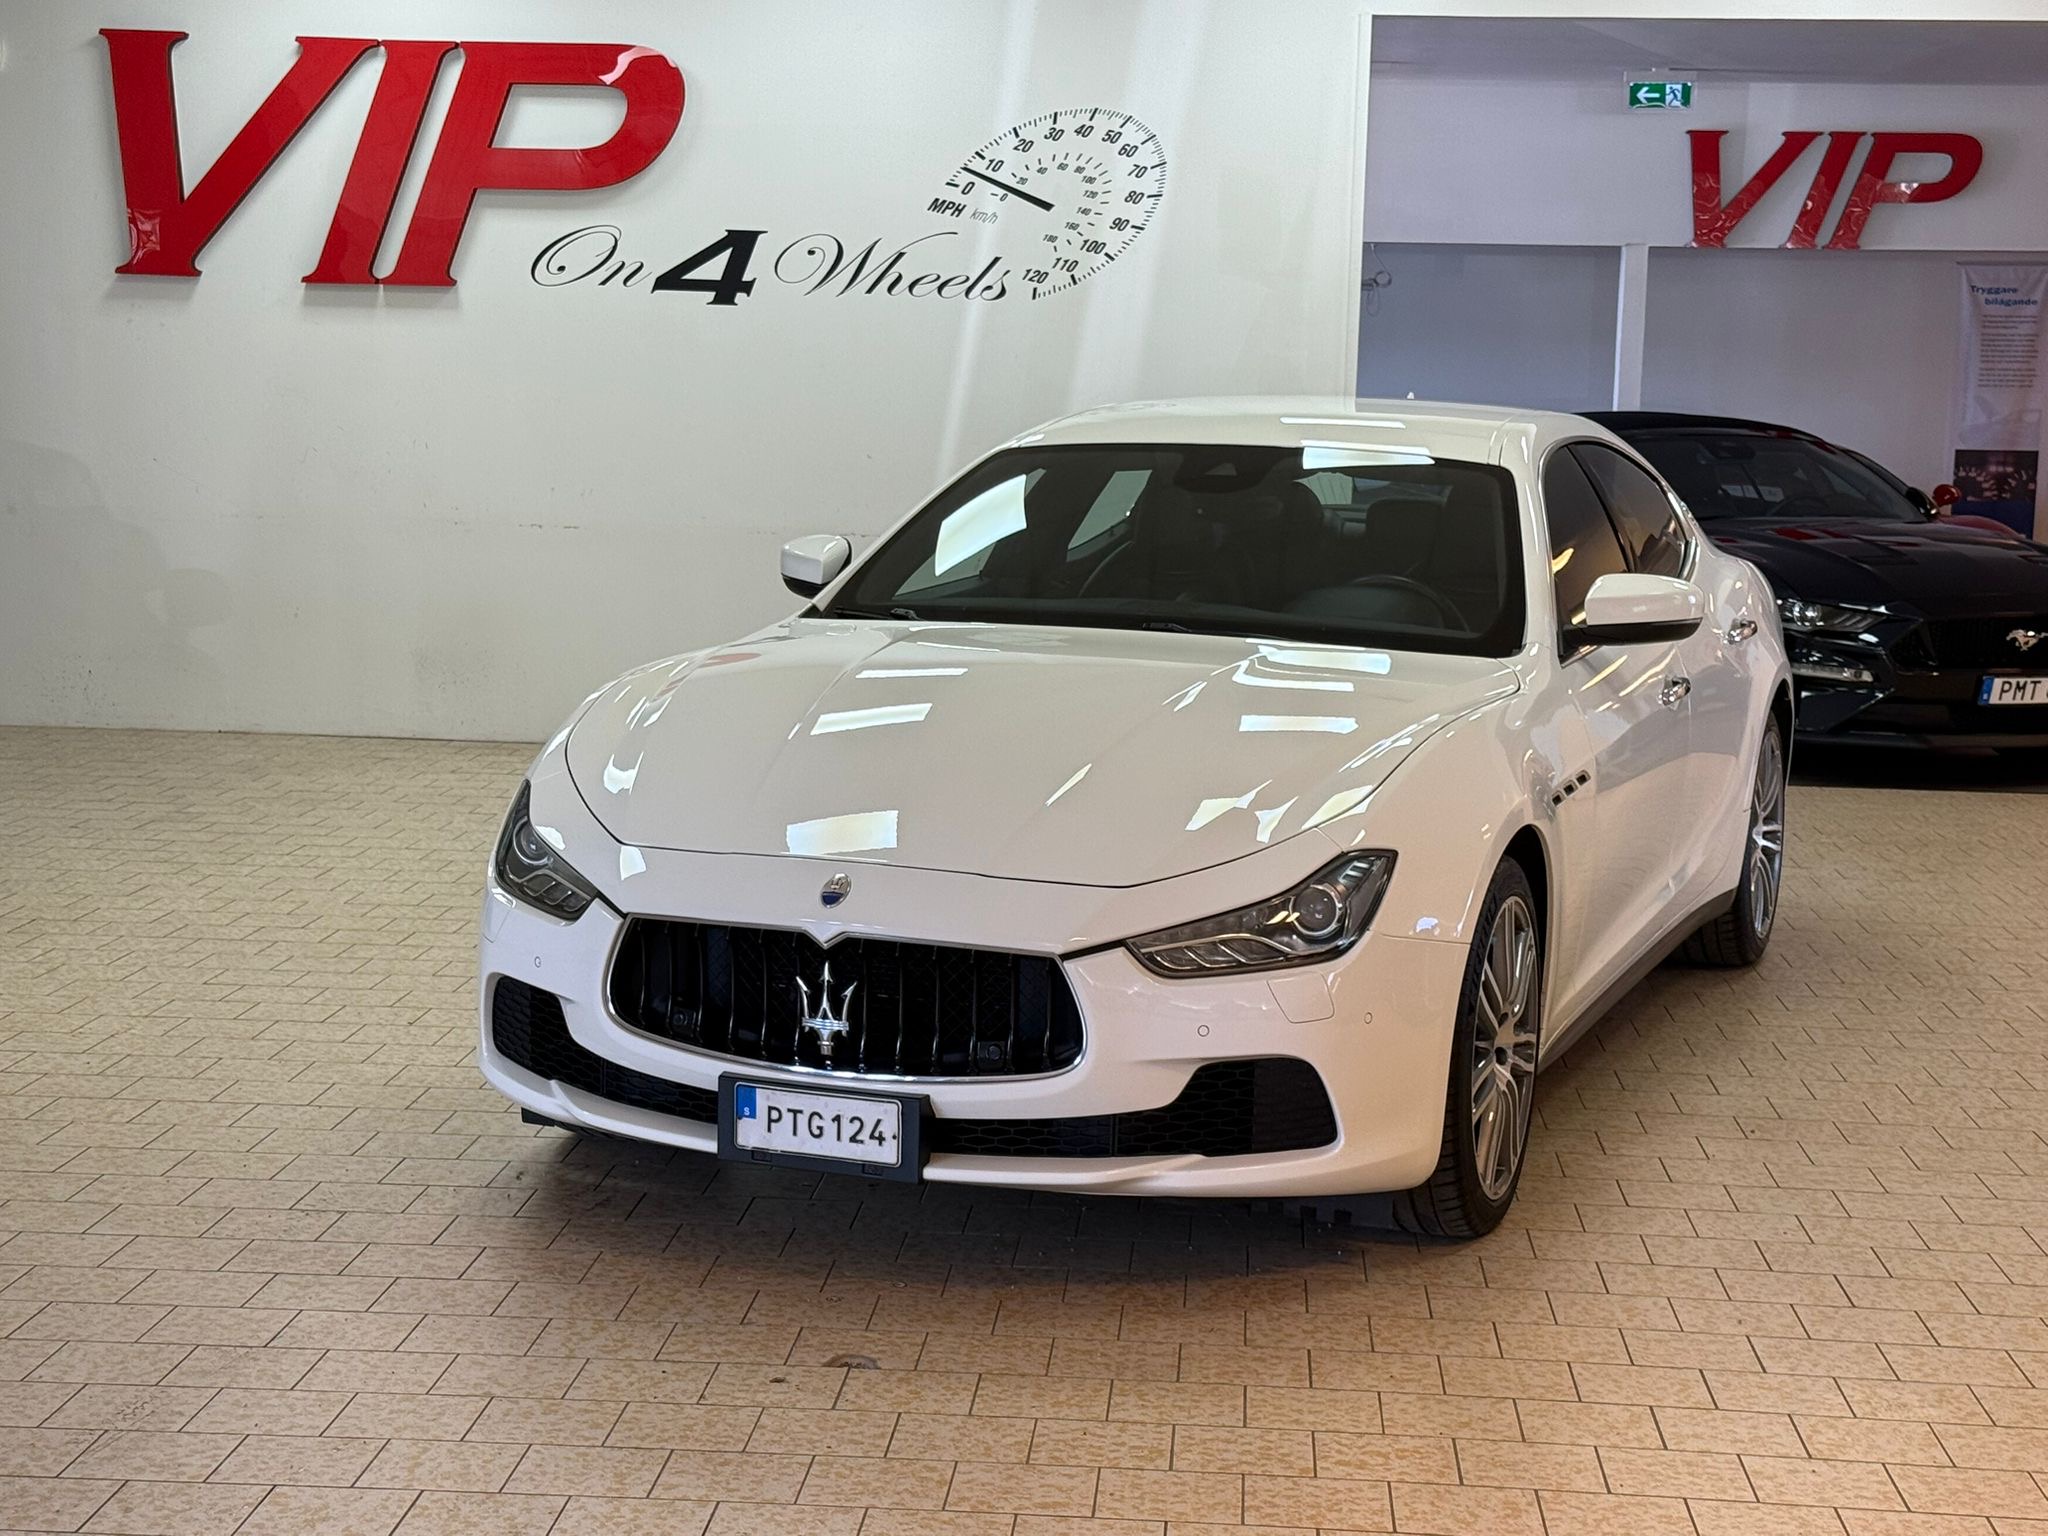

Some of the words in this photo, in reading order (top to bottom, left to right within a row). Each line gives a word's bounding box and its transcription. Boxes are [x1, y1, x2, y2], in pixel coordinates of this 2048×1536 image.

[1043, 128, 1065, 142] 30
[1074, 124, 1095, 138] 40
[1101, 130, 1122, 144] 50
[1013, 139, 1034, 153] 20
[1118, 144, 1139, 158] 60
[99, 28, 685, 287] VIP
[985, 158, 1004, 173] 10
[1036, 167, 1048, 175] 40
[1127, 164, 1148, 179] 70
[961, 181, 975, 195] 0
[1016, 177, 1028, 185] 20
[1686, 130, 1983, 250] VIP
[999, 193, 1008, 202] 0
[1124, 191, 1145, 205] 80
[927, 198, 967, 218] MPH
[969, 208, 999, 225] km/h
[1109, 218, 1130, 232] 90
[1079, 239, 1107, 255] 100
[531, 224, 651, 287] On
[651, 229, 768, 306] 4
[774, 231, 1010, 302] Wheels
[1052, 257, 1079, 273] 110
[1022, 268, 1049, 284] 120
[1998, 681, 2042, 701] PMT
[766, 1105, 886, 1147] PTG124
